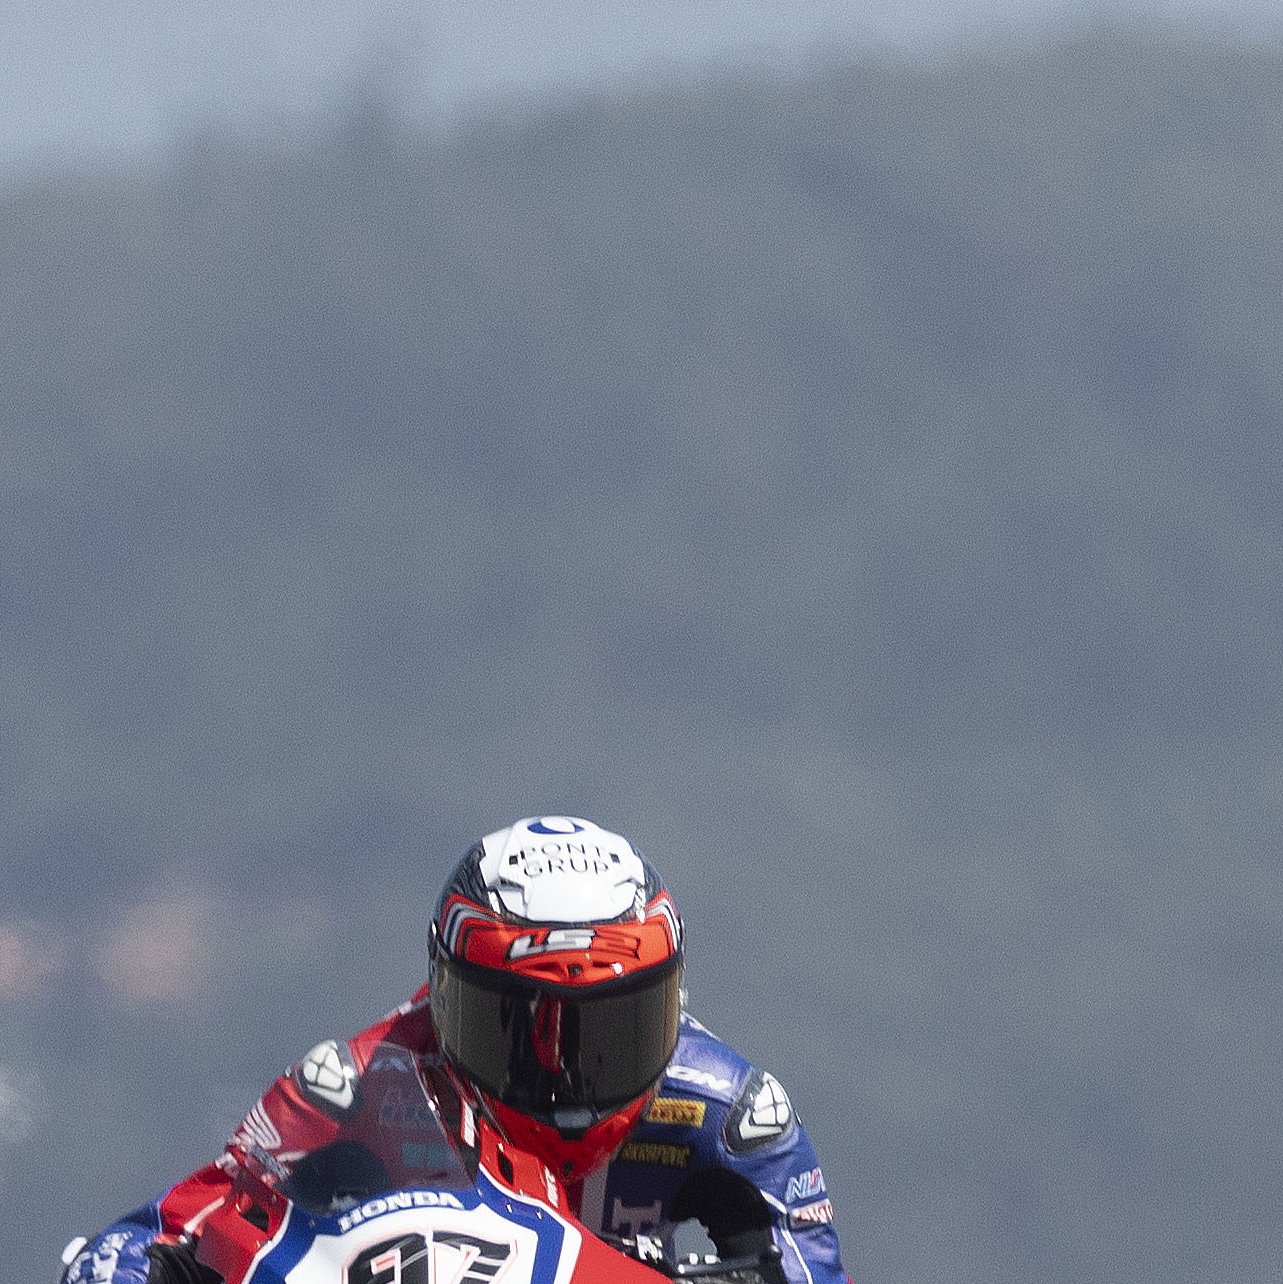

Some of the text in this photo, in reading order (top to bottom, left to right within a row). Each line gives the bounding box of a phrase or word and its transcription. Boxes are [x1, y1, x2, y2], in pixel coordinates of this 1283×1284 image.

[519, 842, 607, 860] PONT
[523, 857, 610, 878] GRUP
[337, 1190, 465, 1233] HONDA
